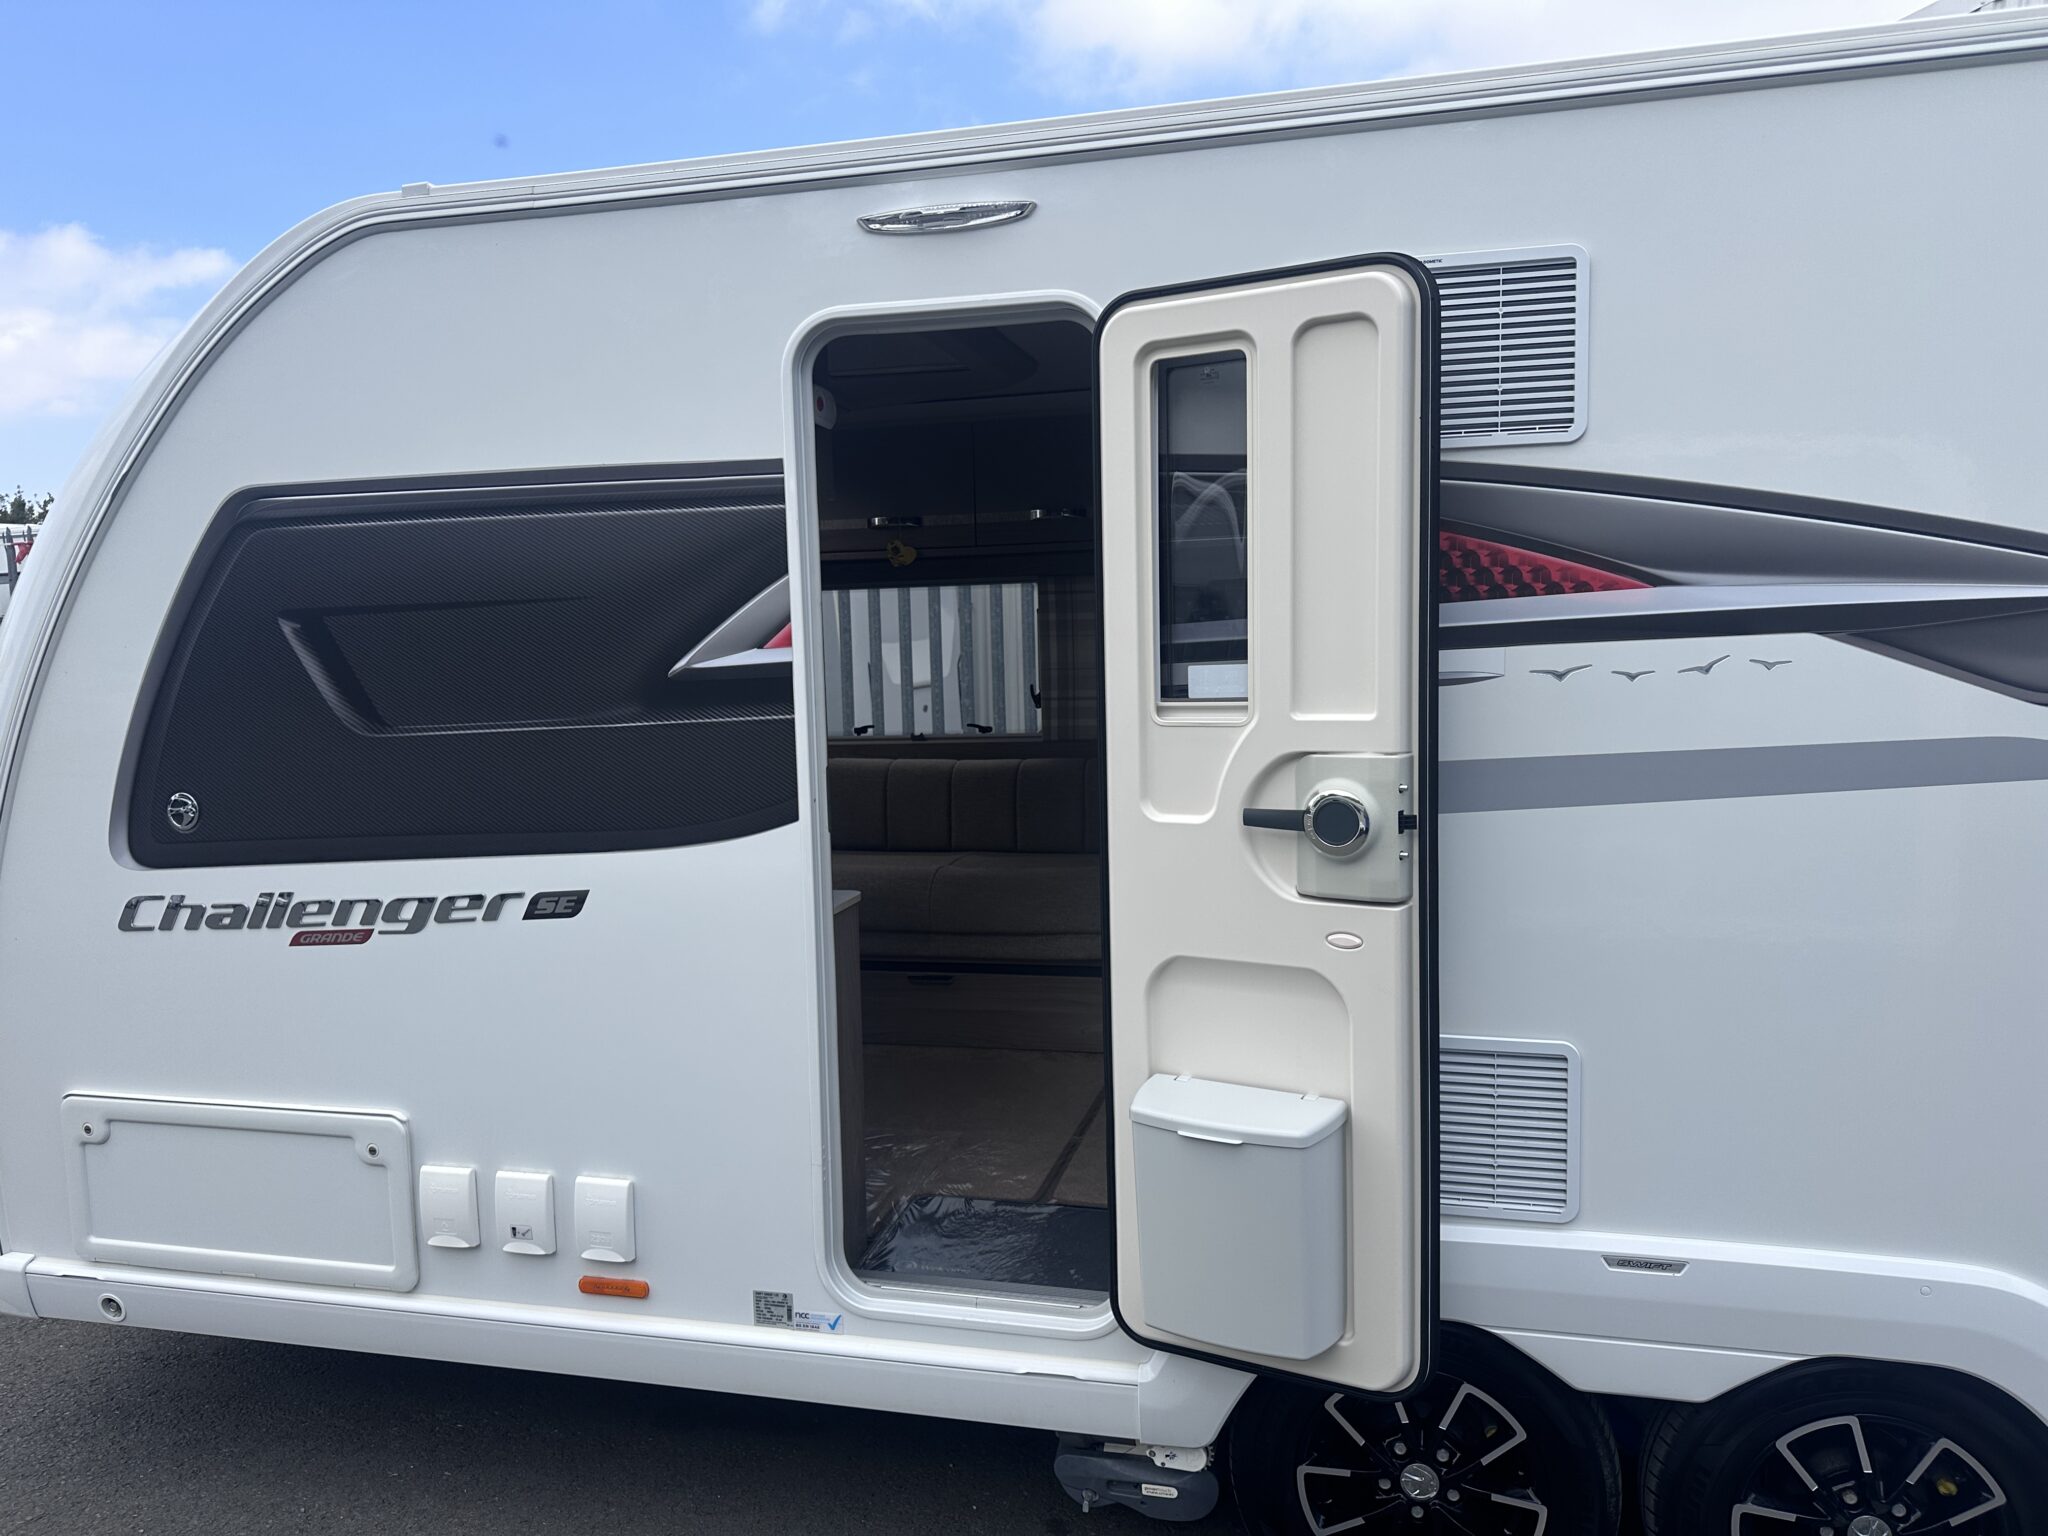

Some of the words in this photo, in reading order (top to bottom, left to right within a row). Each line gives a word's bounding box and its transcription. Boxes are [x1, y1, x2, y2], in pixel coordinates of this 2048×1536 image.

[117, 891, 525, 935] Challenger
[534, 896, 577, 914] SE
[300, 932, 365, 944] GRANDE
[1617, 1259, 1672, 1270] SWIFT
[795, 1312, 810, 1320] ncc
